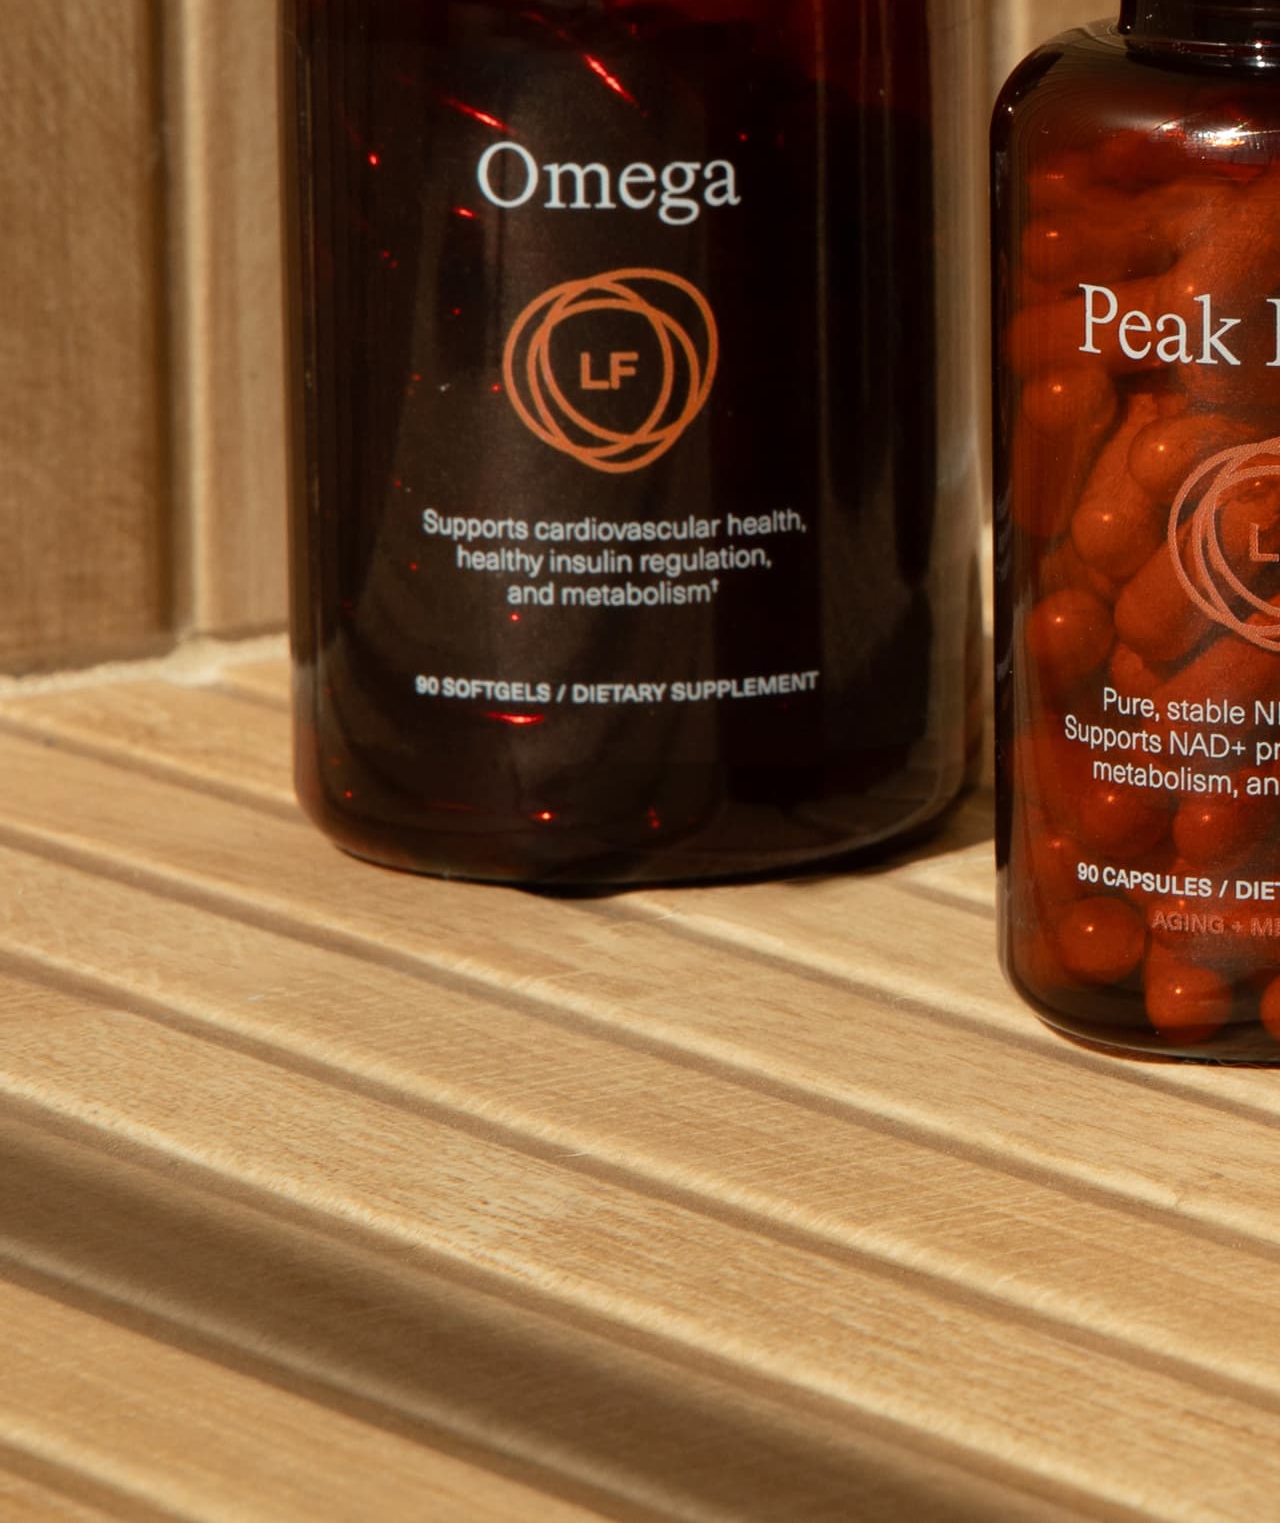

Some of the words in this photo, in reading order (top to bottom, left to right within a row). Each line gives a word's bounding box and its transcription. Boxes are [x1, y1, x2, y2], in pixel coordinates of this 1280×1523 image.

[477, 141, 741, 226] Omega
[1079, 283, 1241, 366] Peak
[580, 352, 639, 390] LF
[422, 509, 529, 541] Supports
[535, 514, 721, 542] cardiovascular
[726, 509, 807, 538] health,
[457, 545, 545, 576] healthy
[549, 546, 633, 573] insulin
[640, 545, 773, 576] regulation,
[507, 582, 554, 606] and
[415, 676, 439, 694] 90
[442, 677, 551, 703] SOFTGELS
[572, 683, 667, 703] DIETARY
[671, 671, 819, 702] SUPPLEMENT
[1103, 687, 1162, 721] Pure,
[1166, 694, 1246, 725] stable
[1064, 715, 1162, 754] Supports
[1168, 734, 1247, 759] NAD+
[1093, 758, 1239, 798] metabolism,
[1077, 863, 1100, 884] 90
[1102, 865, 1213, 898] CAPSULES
[1151, 911, 1226, 935] AGING
